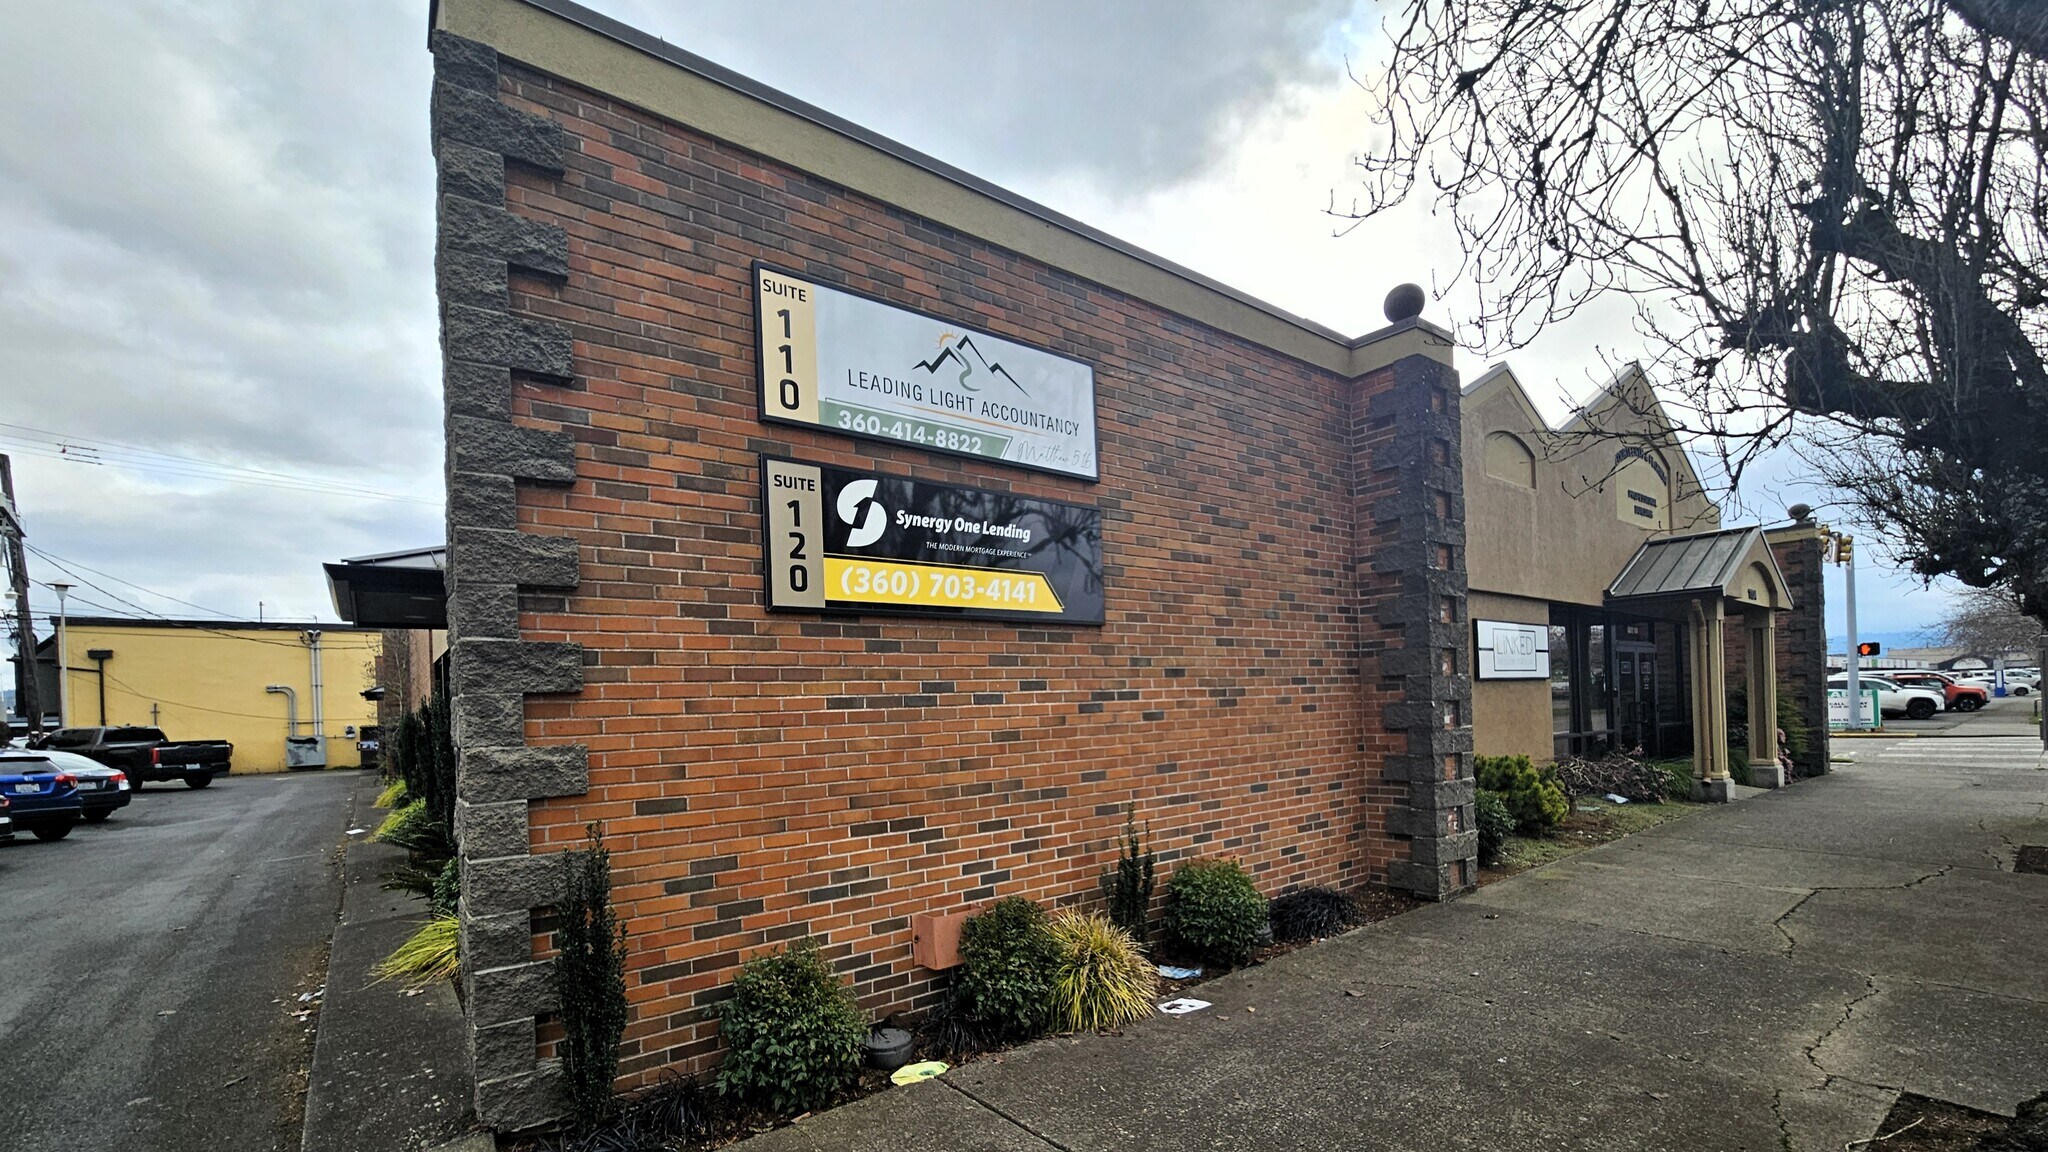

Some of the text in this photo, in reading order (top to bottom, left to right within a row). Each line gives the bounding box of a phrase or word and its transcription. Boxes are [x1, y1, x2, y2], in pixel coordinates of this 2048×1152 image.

[763, 279, 806, 302] SUITE
[777, 308, 800, 410] 110
[848, 368, 1080, 437] LEADING LIGHT ACCOUNTANCY
[838, 410, 982, 454] 360-414-8822
[773, 474, 815, 492] SUITE
[896, 510, 1031, 543] Synergy One Lending
[787, 500, 809, 592] 120
[938, 543, 965, 552] MODERN
[965, 546, 996, 556] MORTGAGE
[841, 566, 1036, 604] (360) 703-4141
[1496, 634, 1534, 656] LINKED
